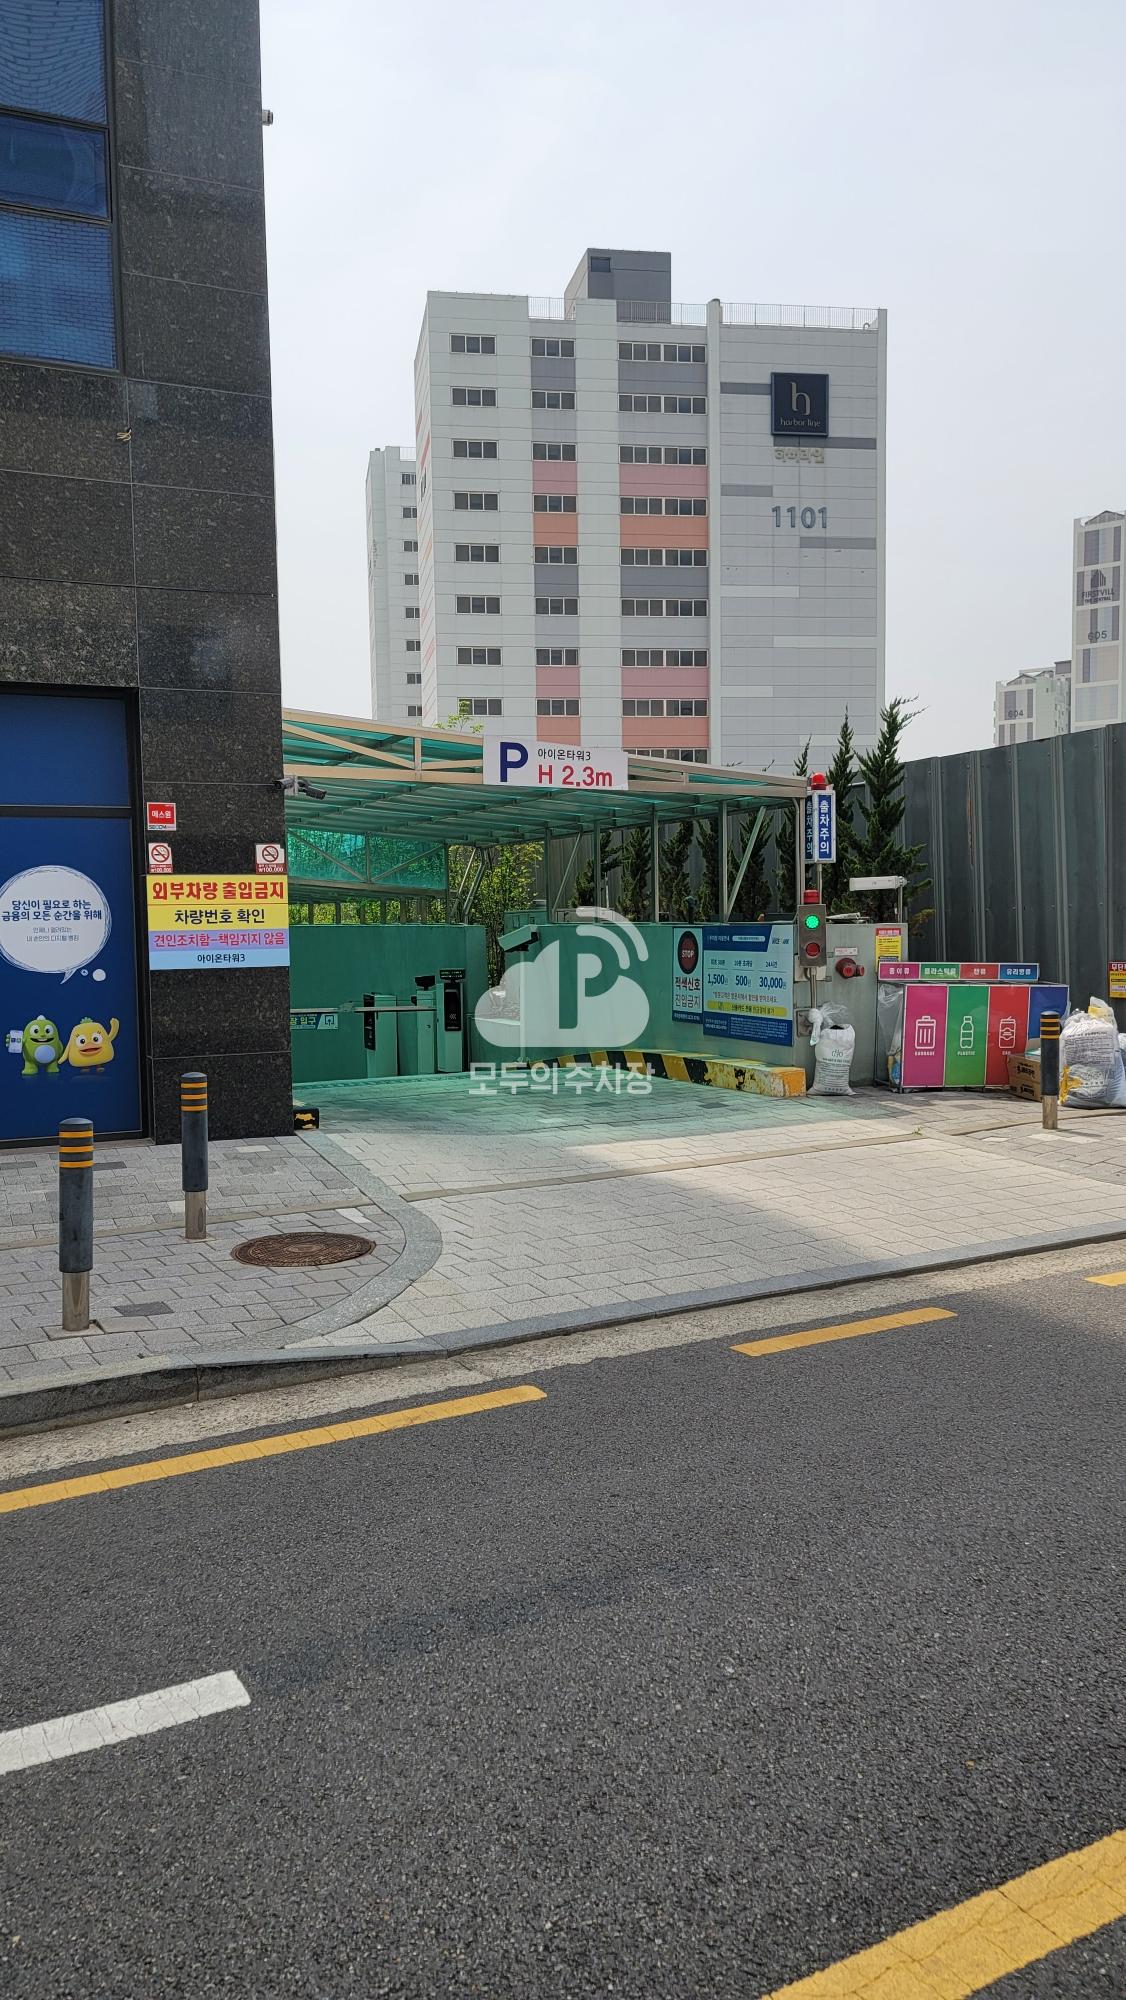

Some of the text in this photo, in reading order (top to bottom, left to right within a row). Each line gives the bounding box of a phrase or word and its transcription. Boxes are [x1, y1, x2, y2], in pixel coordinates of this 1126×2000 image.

[780, 417, 821, 427] harbor line
[772, 506, 827, 528] 1101
[1088, 630, 1107, 640] 605
[537, 748, 591, 761] 아이온타워3
[500, 741, 529, 782] P
[538, 764, 613, 787] H 2.3m
[819, 799, 830, 855] 출차주의
[152, 881, 284, 900] 외부차량 출입금지
[12, 900, 91, 910] 당신이 필요로 하는
[2, 910, 102, 921] 금융의 모든 순간을 위해
[174, 908, 265, 925] 차량번호 확인
[263, 932, 285, 945] 않음
[197, 953, 246, 964] 아이온타워3
[681, 950, 695, 958] STOP
[675, 994, 700, 1008] 진입금지
[300, 1016, 317, 1025] 입구
